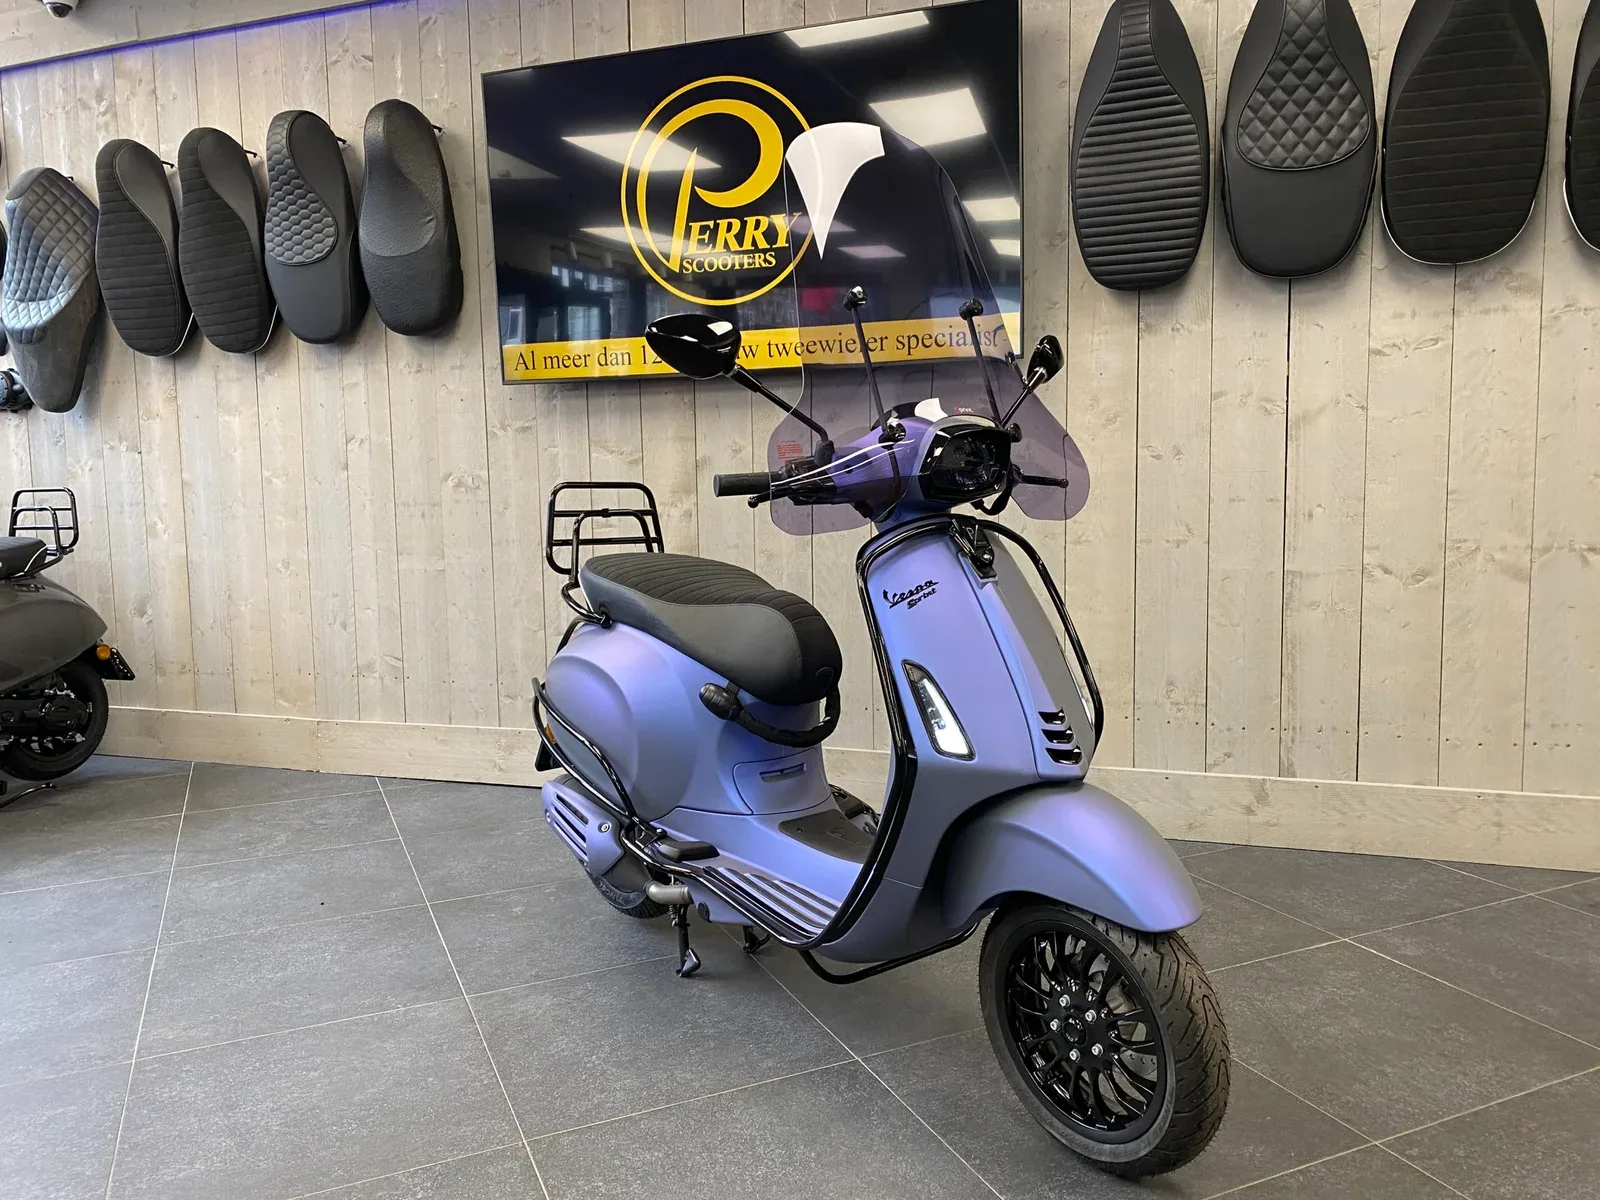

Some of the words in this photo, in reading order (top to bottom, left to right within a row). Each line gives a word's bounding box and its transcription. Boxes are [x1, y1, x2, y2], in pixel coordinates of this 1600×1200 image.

[682, 252, 776, 274] SCOOTERS
[515, 351, 536, 370] Al
[543, 350, 591, 368] meer
[597, 346, 631, 366] dan
[767, 331, 888, 358] tweewieer
[895, 324, 998, 356] speciaist
[882, 580, 939, 609] Vespa
[907, 588, 937, 609] Sprint
